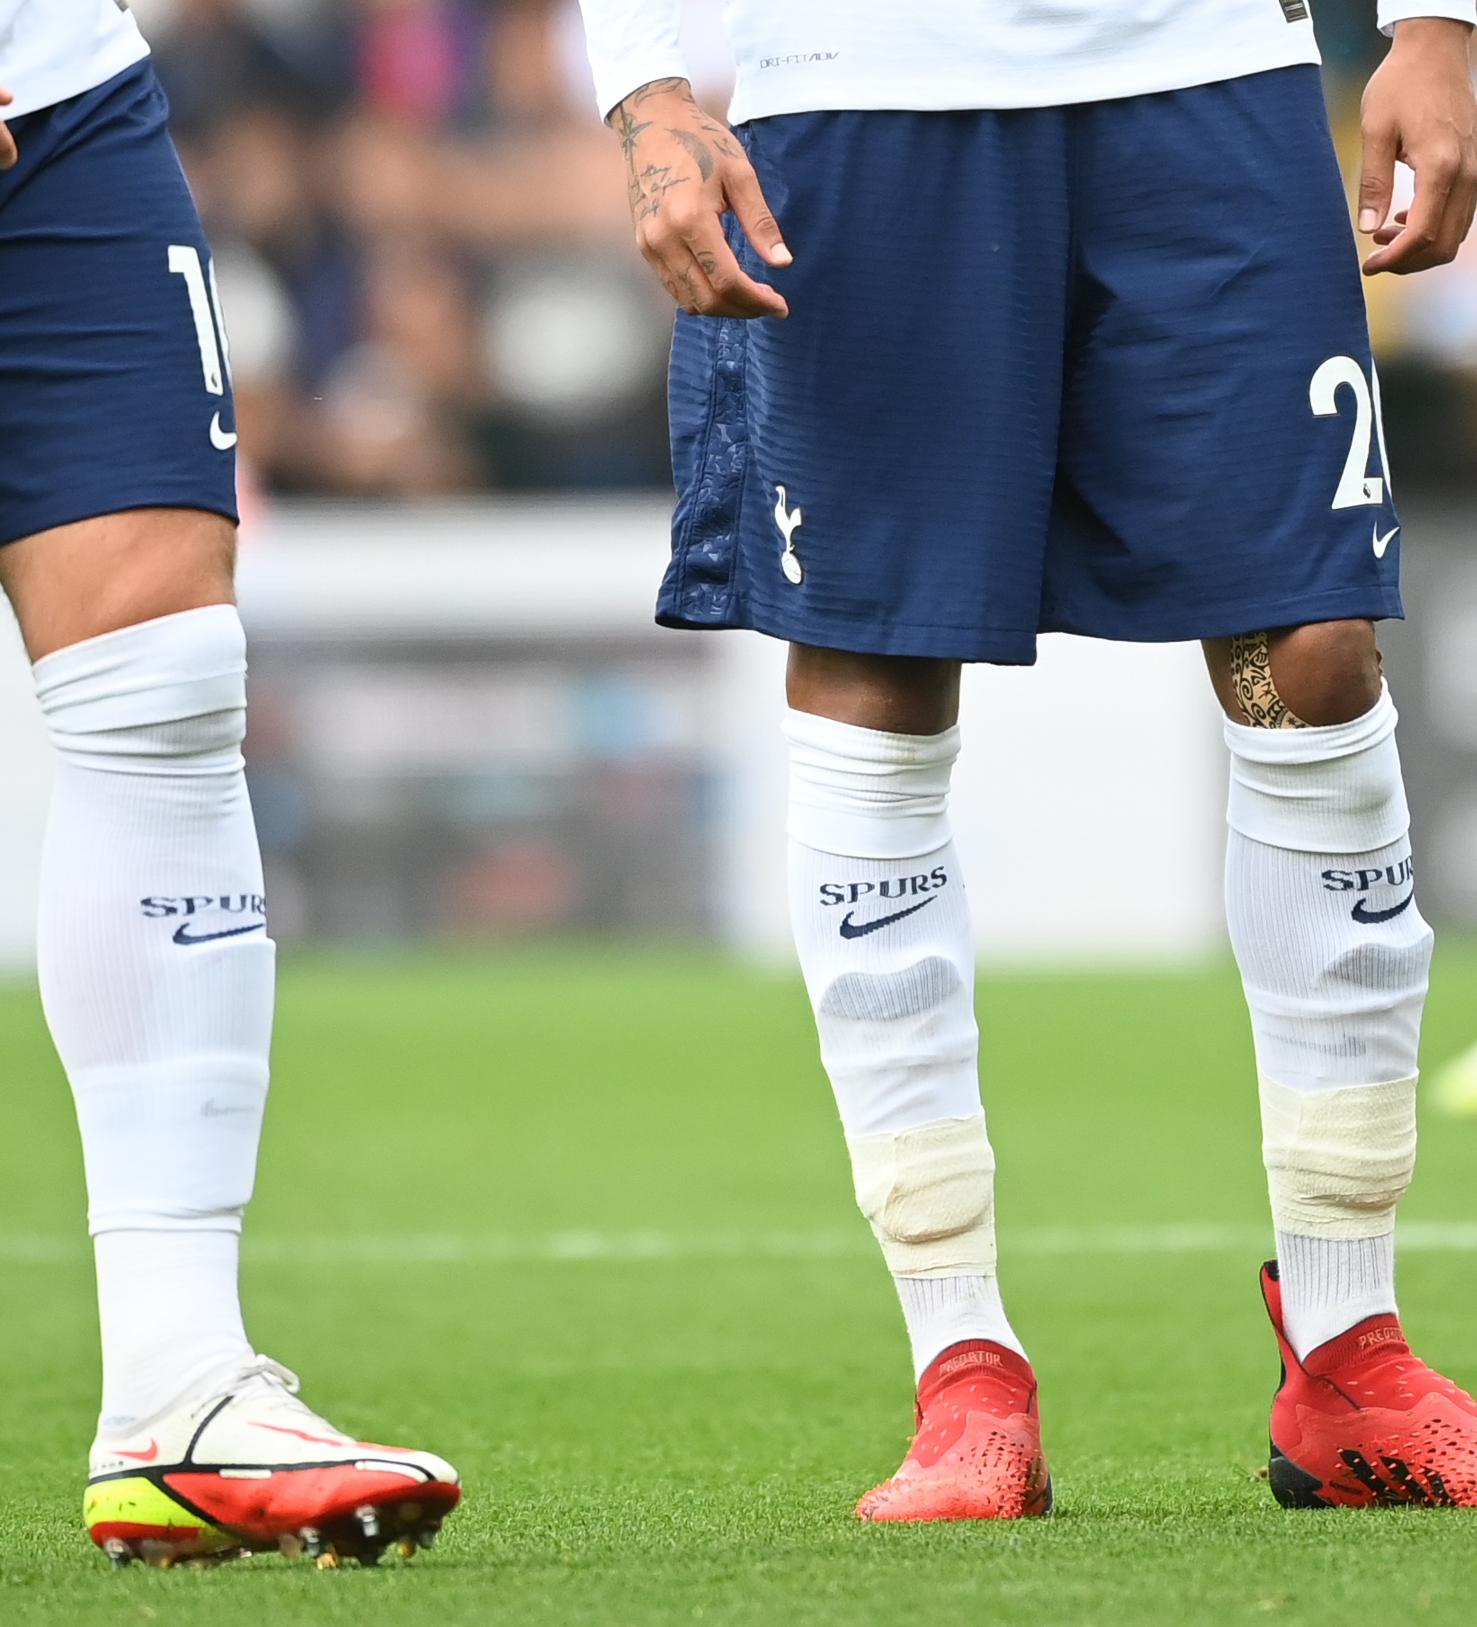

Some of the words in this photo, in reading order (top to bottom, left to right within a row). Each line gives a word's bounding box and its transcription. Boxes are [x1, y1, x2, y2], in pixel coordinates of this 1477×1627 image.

[167, 244, 233, 397] 1
[1309, 355, 1393, 511] 2
[819, 865, 948, 907] SPURS
[1321, 854, 1414, 892] SPUR
[140, 892, 267, 918] SPUR
[938, 1350, 1004, 1376] PREDATOR
